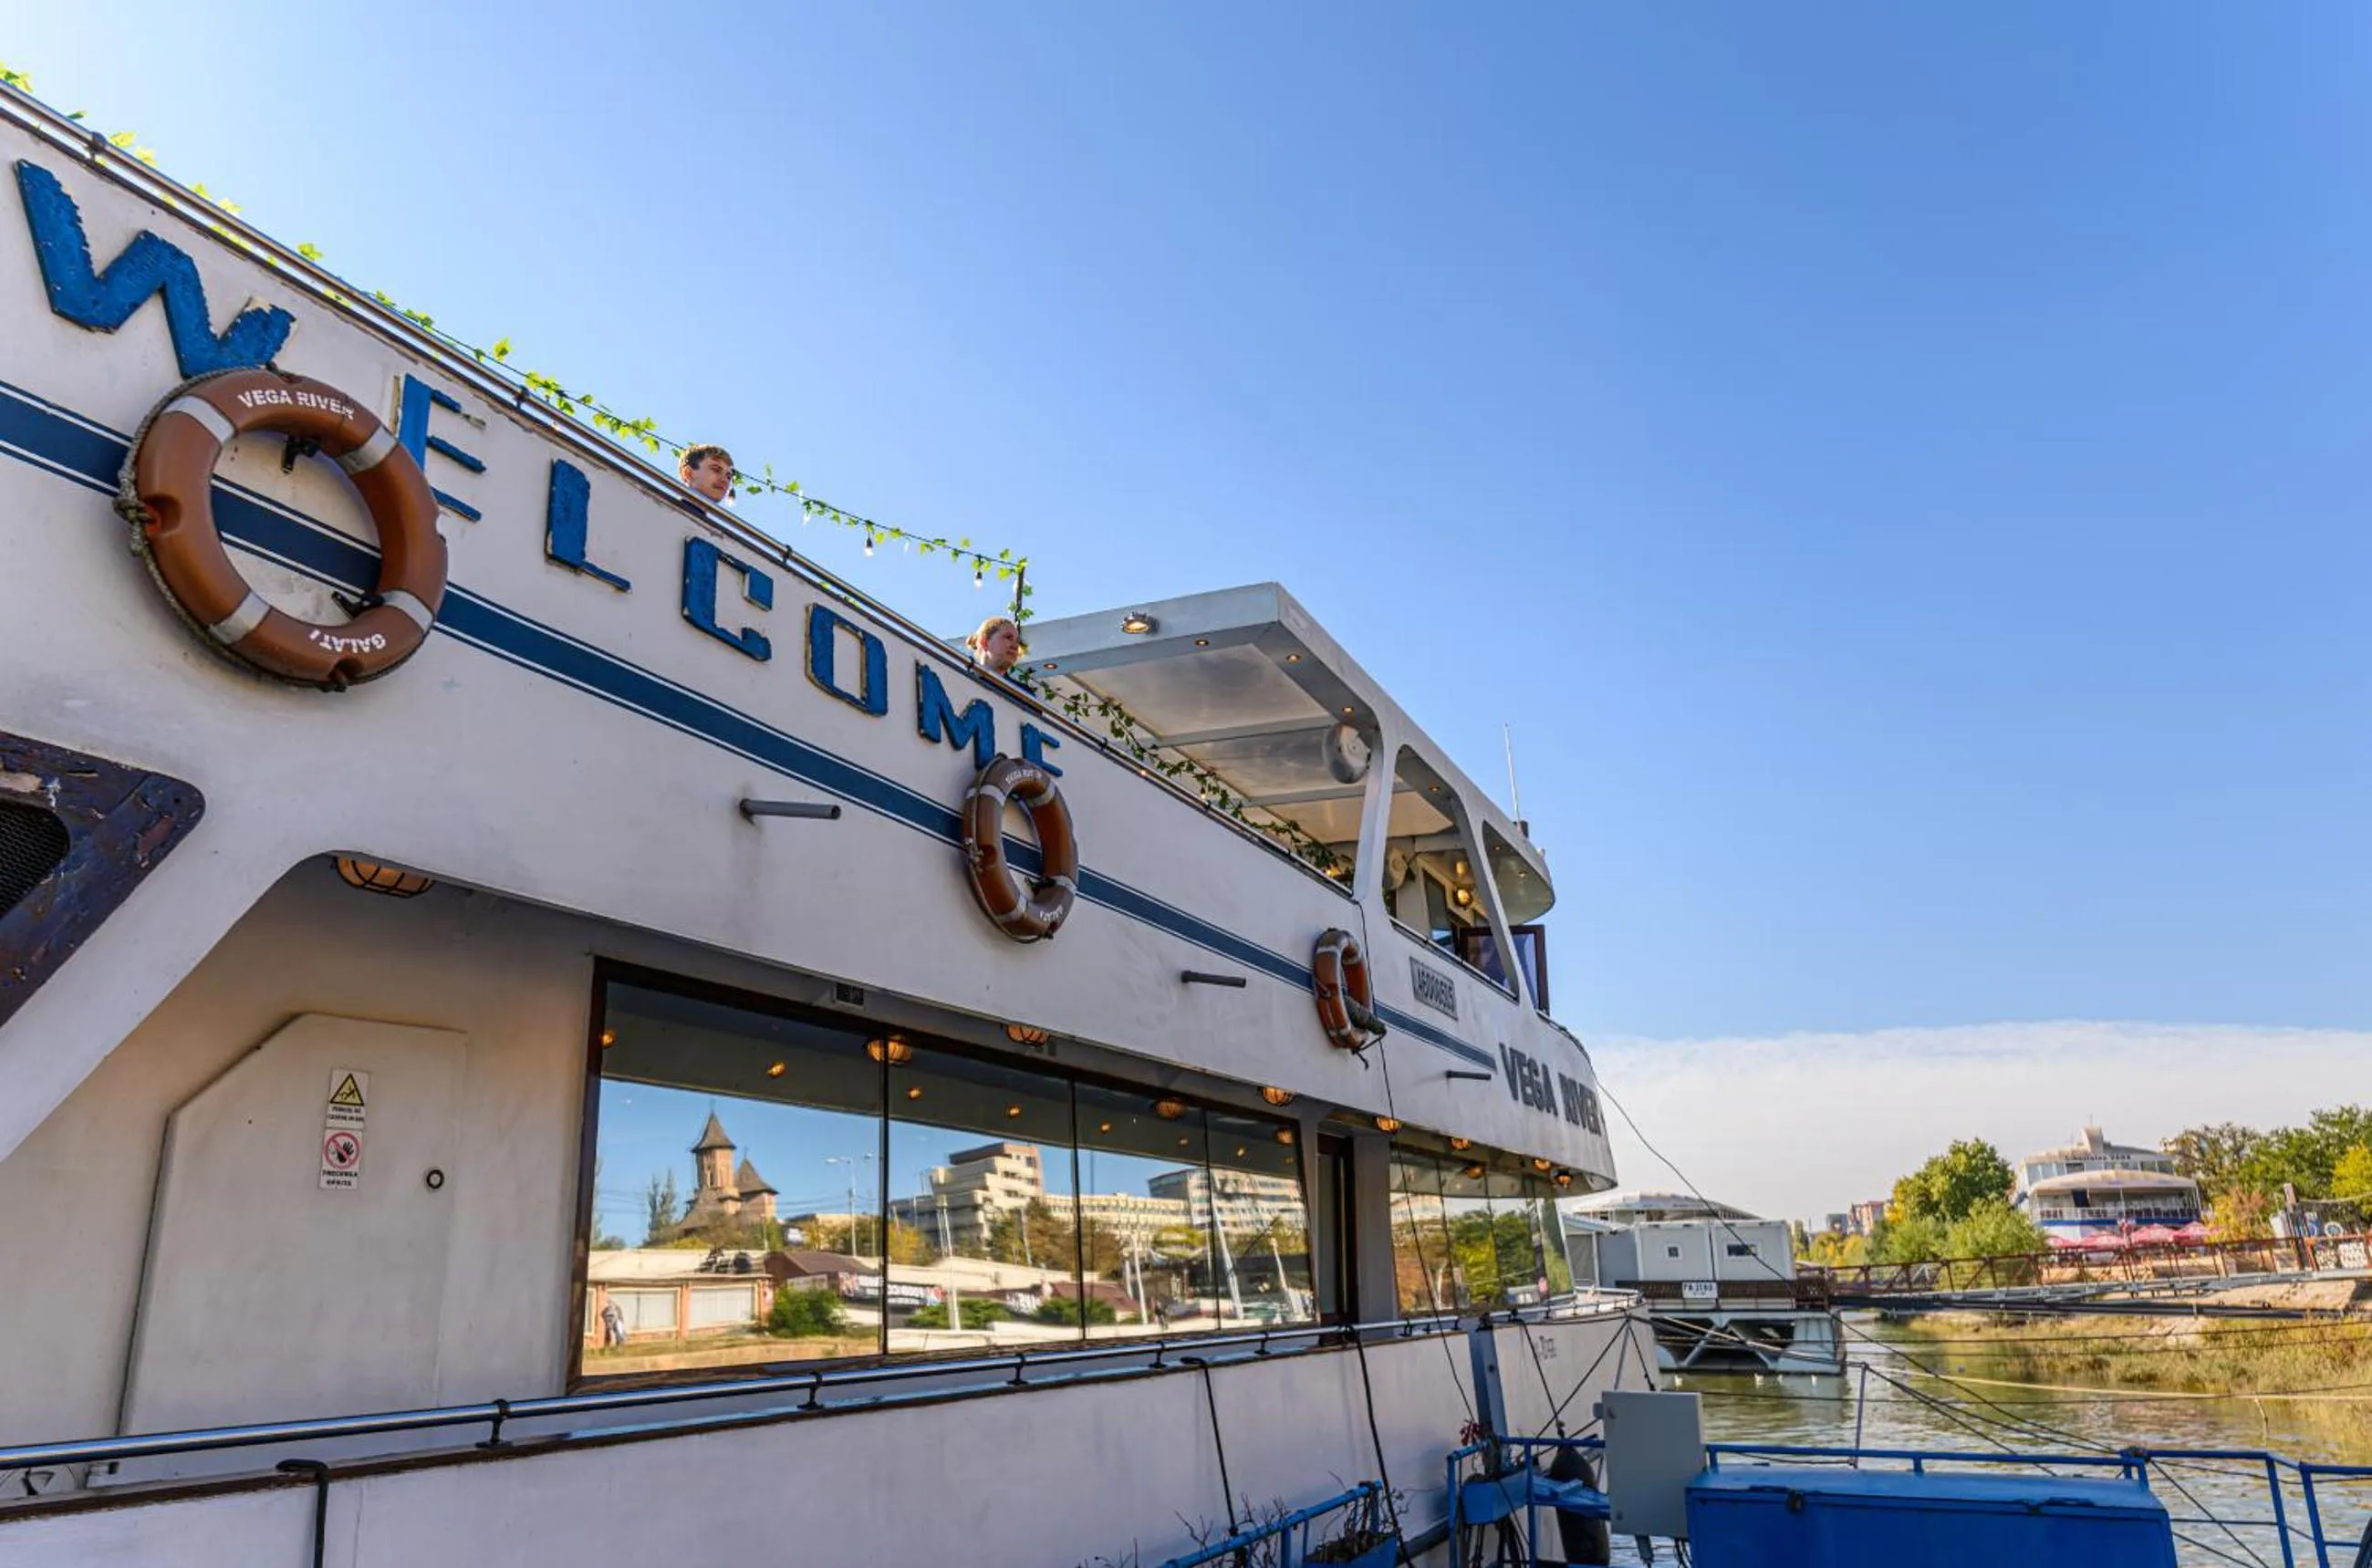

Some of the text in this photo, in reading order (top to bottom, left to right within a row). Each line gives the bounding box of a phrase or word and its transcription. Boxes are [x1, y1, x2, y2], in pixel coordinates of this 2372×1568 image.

[237, 389, 355, 420] VEGA RIVER
[1498, 1042, 1558, 1117] VEGA
